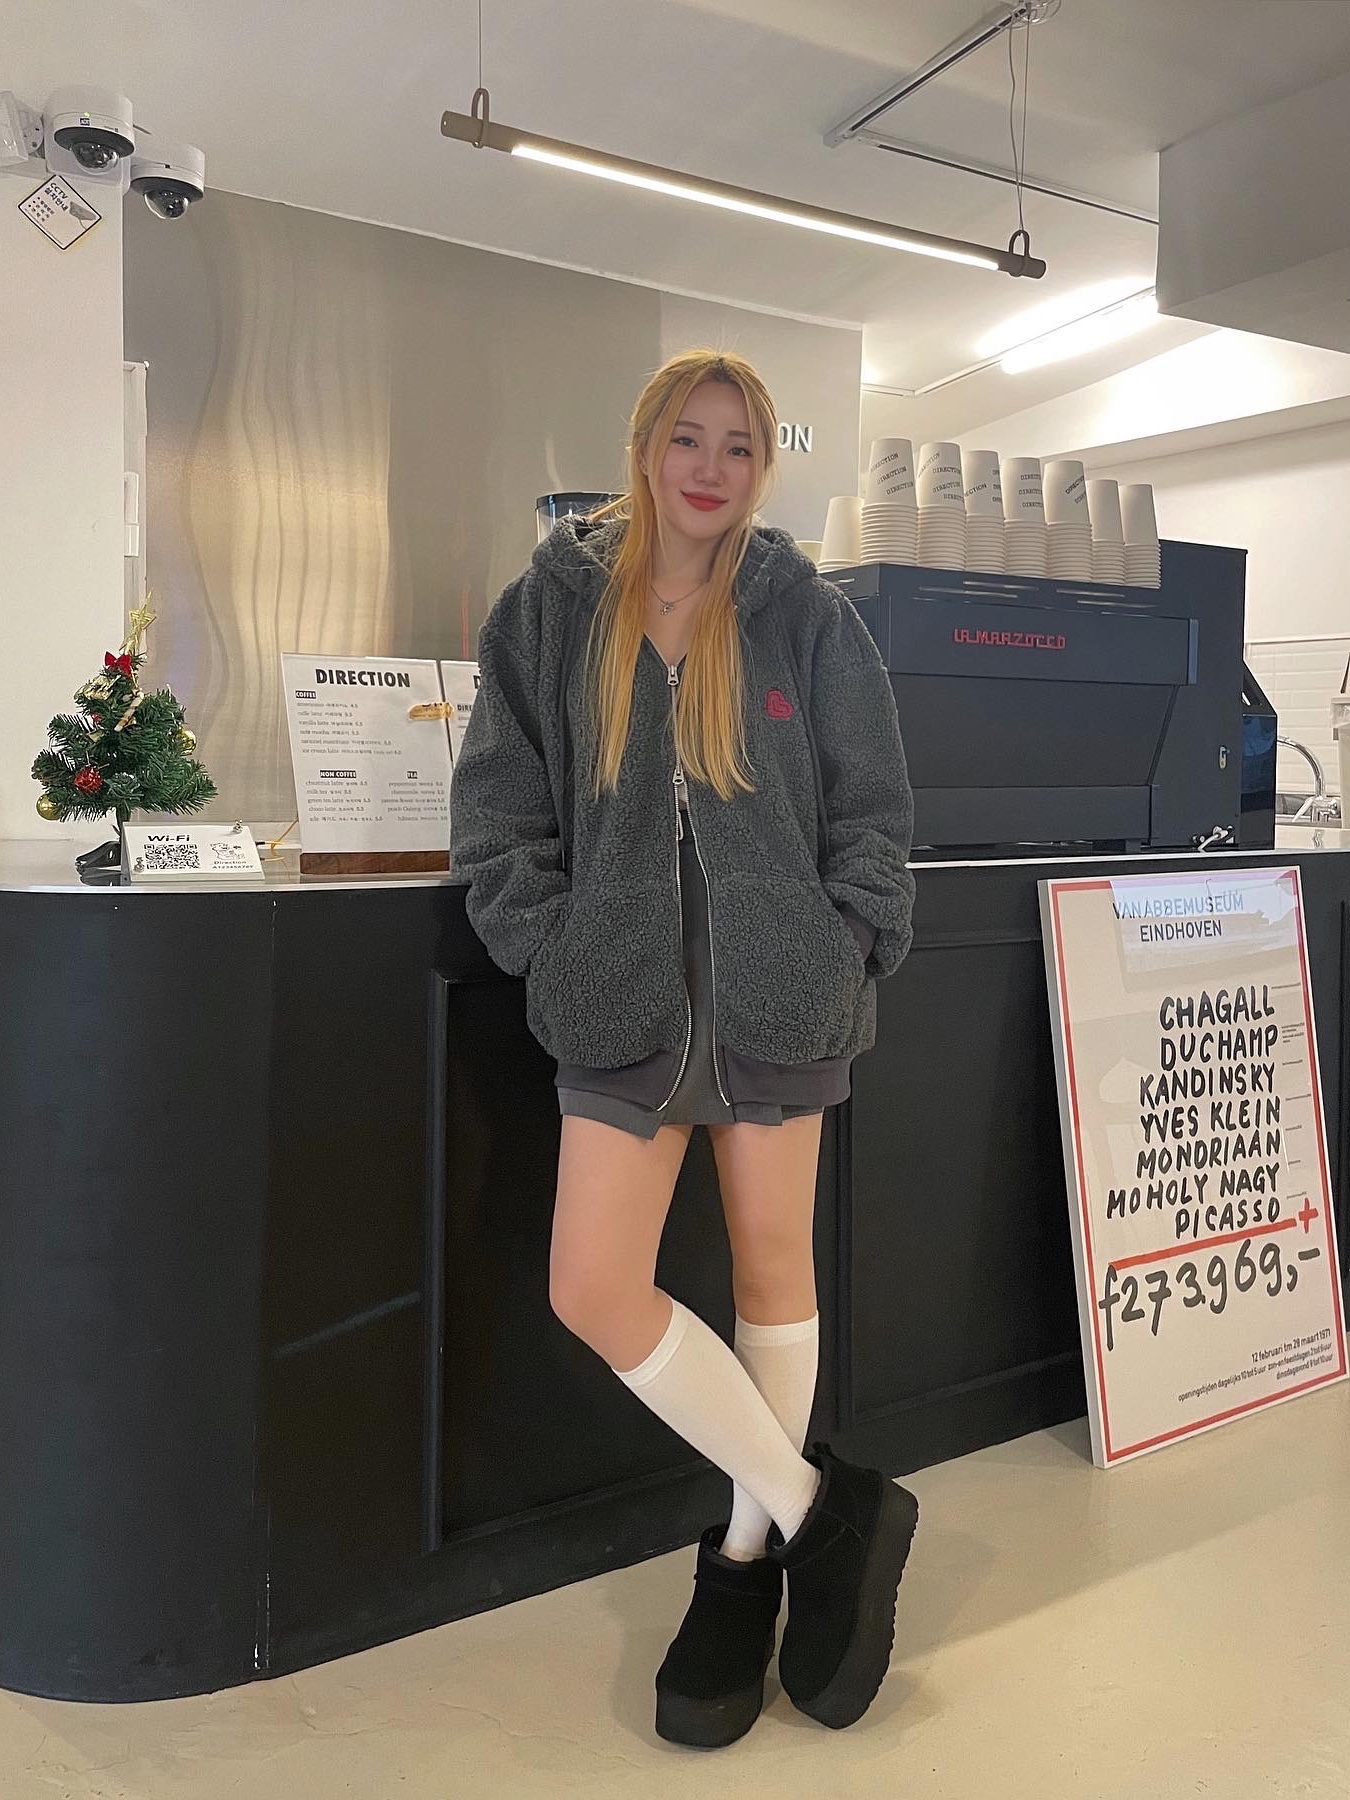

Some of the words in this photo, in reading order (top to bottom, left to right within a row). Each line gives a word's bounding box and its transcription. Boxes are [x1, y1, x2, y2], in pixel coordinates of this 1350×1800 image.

[50, 182, 69, 199] CCTV
[315, 668, 411, 688] DIRECTION
[1140, 919, 1222, 942] EINDHOVEN
[1159, 984, 1275, 1031] CHAGALL
[1160, 1024, 1278, 1071] DUCHAMP
[1139, 1062, 1275, 1110] KANDINSKY
[1140, 1105, 1199, 1144] YVES
[1210, 1096, 1281, 1132] KLEIN
[1136, 1129, 1281, 1179] MONDRIAAN
[1220, 1162, 1280, 1198] NAGY
[1175, 1197, 1280, 1239] PICASSO
[1251, 1352, 1258, 1363] 12
[1259, 1344, 1283, 1360] februari
[1300, 1332, 1319, 1346] maart
